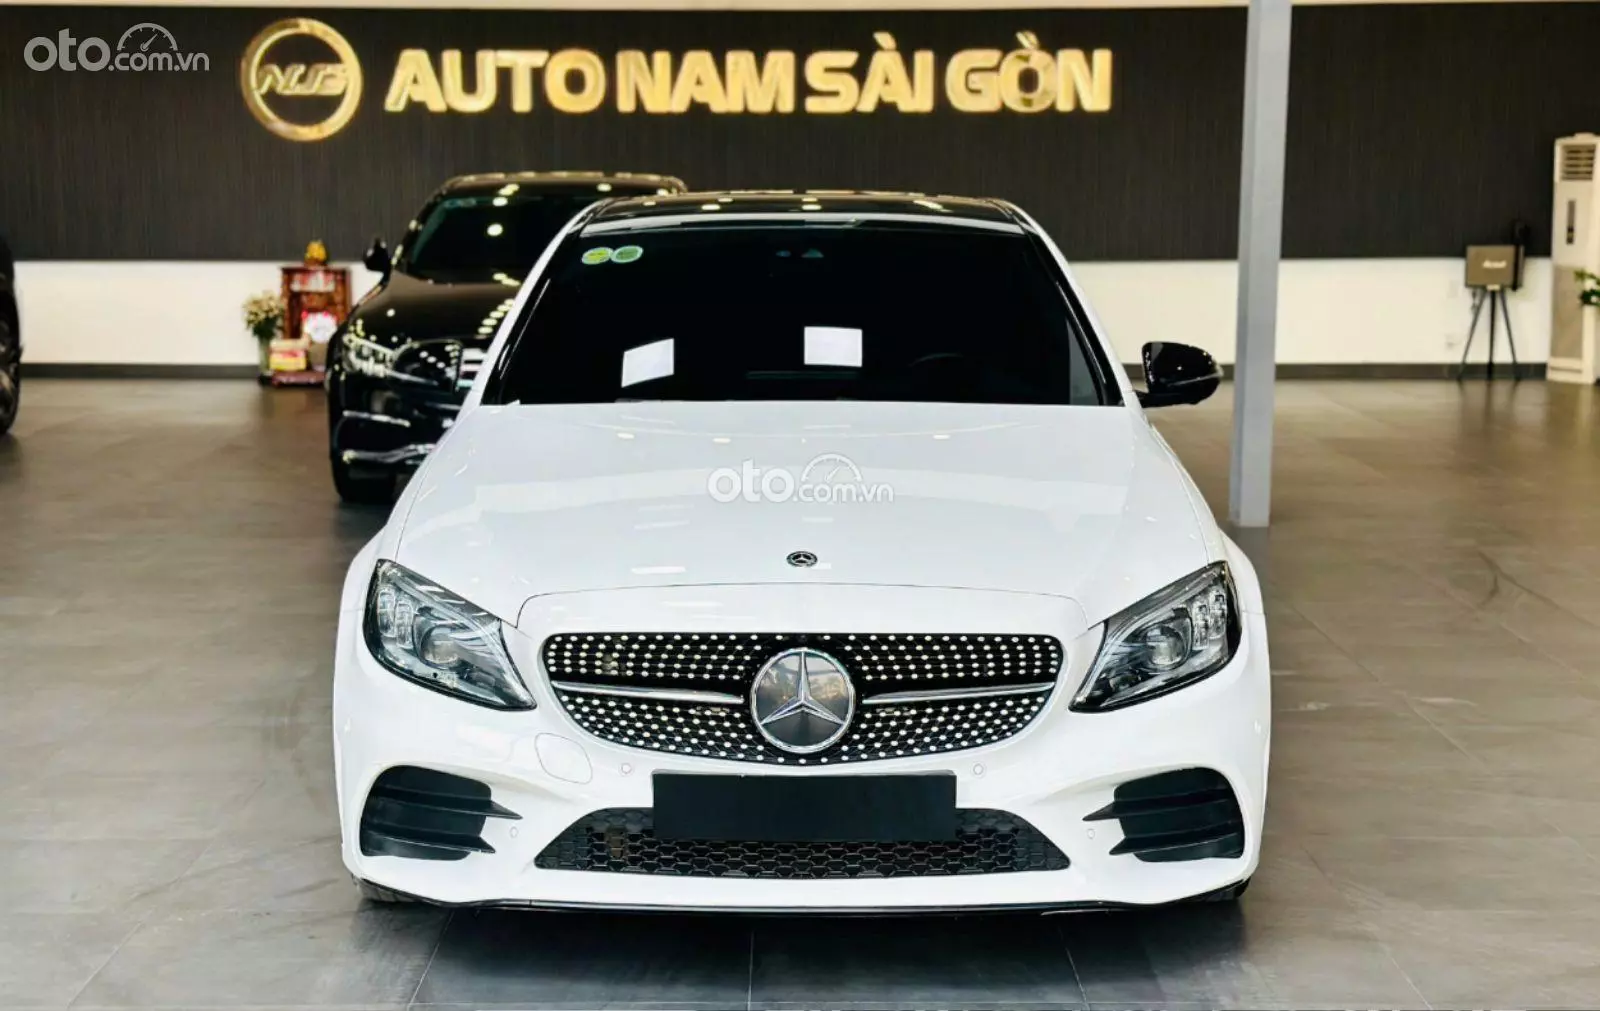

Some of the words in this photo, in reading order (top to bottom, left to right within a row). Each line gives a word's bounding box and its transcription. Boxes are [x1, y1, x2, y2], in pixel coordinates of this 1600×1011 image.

[384, 49, 606, 114] AUTO
[615, 49, 796, 114] NAM
[803, 31, 935, 114] SÀI
[944, 31, 1113, 114] GÒN
